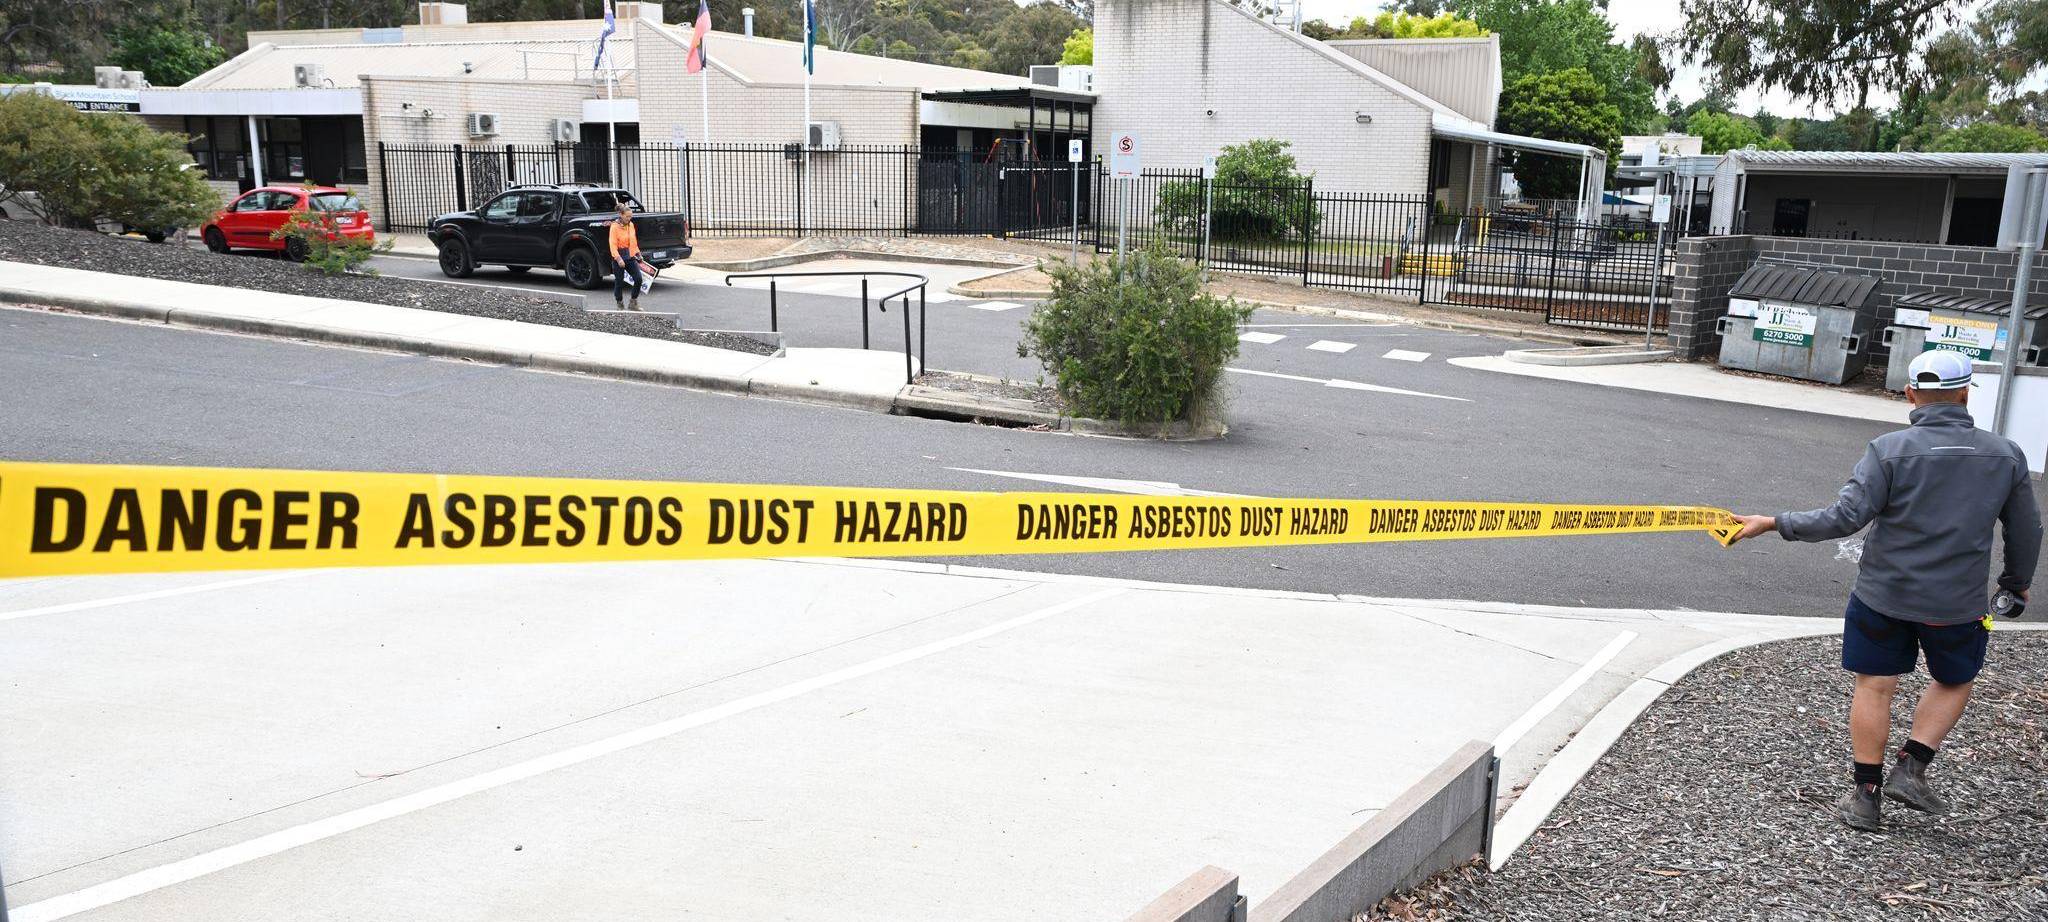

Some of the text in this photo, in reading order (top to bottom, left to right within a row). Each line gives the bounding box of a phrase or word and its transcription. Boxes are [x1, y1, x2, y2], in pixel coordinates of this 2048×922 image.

[90, 102, 129, 110] ENTRANCE
[1929, 315, 1975, 327] CARDBOARD
[1763, 330, 1804, 341] 6270 5000
[1959, 346, 1980, 356] 5000
[31, 487, 360, 553] DANGER
[395, 493, 683, 549] ASBESTOS
[707, 498, 814, 545] DUST
[834, 501, 967, 543] HAZARD
[1016, 504, 1118, 541] DANGER
[1128, 506, 1231, 539] ASBESTOS
[1240, 507, 1283, 537] DUST
[1290, 508, 1349, 536] HAZARD
[1368, 509, 1419, 534] DANGER
[1421, 509, 1477, 533] ASBESTOS
[1478, 510, 1505, 532] DUST
[1506, 511, 1542, 531] HAZARD
[1551, 511, 1583, 530] DANGER
[1582, 511, 1617, 529] ASBESTOS
[1616, 511, 1634, 528] DUST
[1634, 511, 1655, 527] HAZARD
